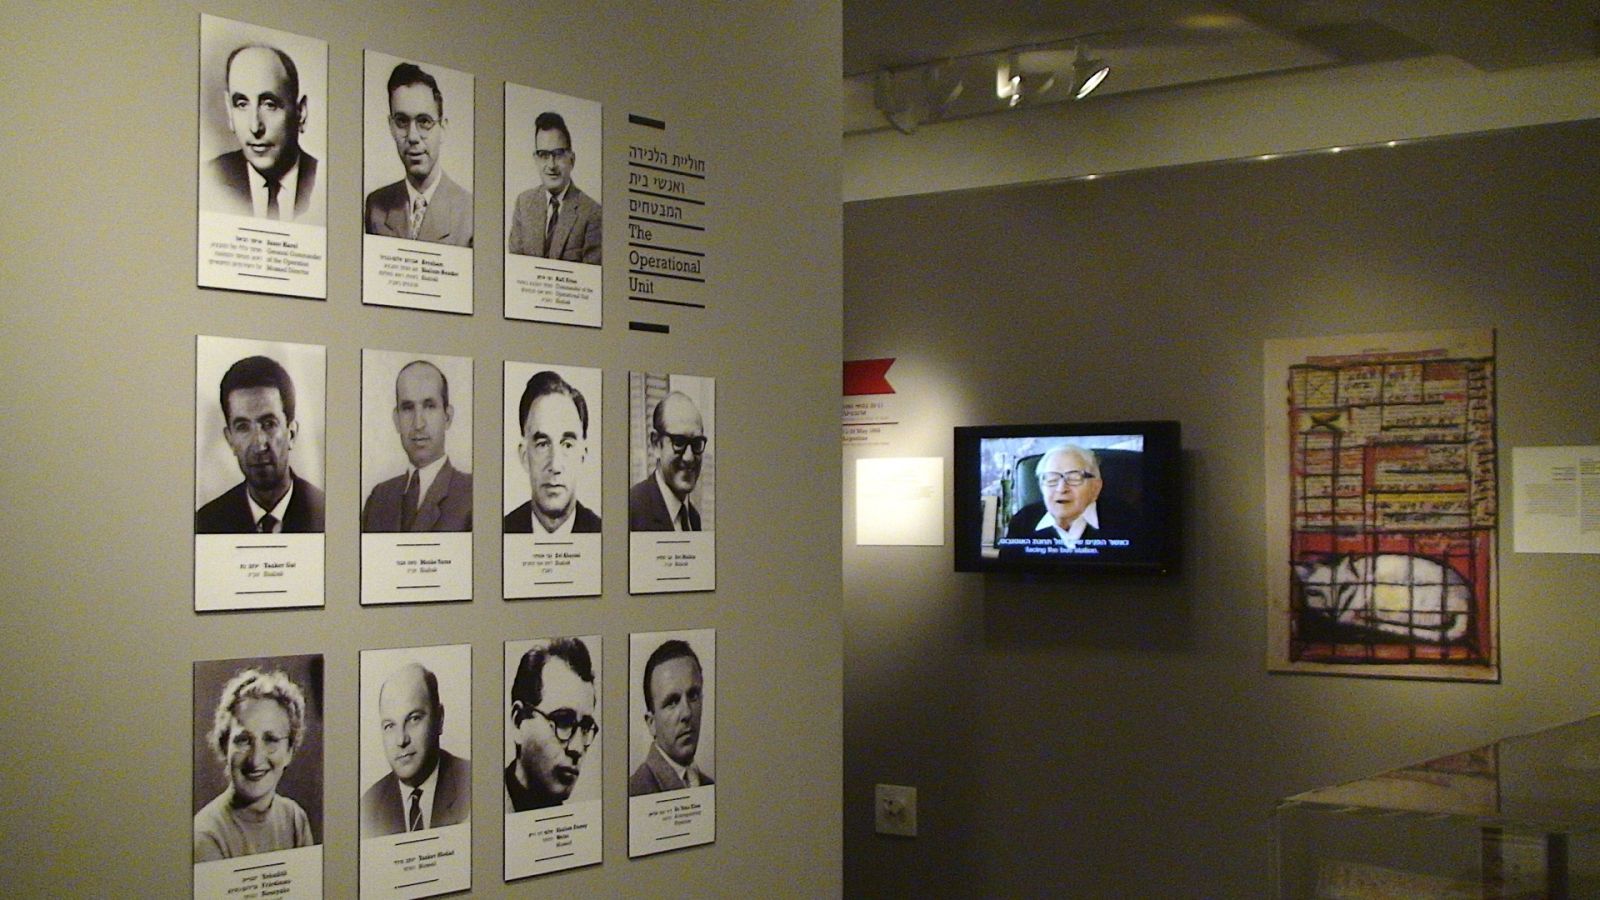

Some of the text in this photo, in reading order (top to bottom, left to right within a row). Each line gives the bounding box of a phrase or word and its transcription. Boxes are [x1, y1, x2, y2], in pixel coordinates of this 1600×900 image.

[629, 145, 705, 172] חוליית הלכידה
[629, 172, 685, 194] ואנשי בית
[629, 199, 682, 220] המבטחים
[629, 223, 652, 241] The
[629, 250, 701, 274] Operational
[629, 276, 654, 294] Unit
